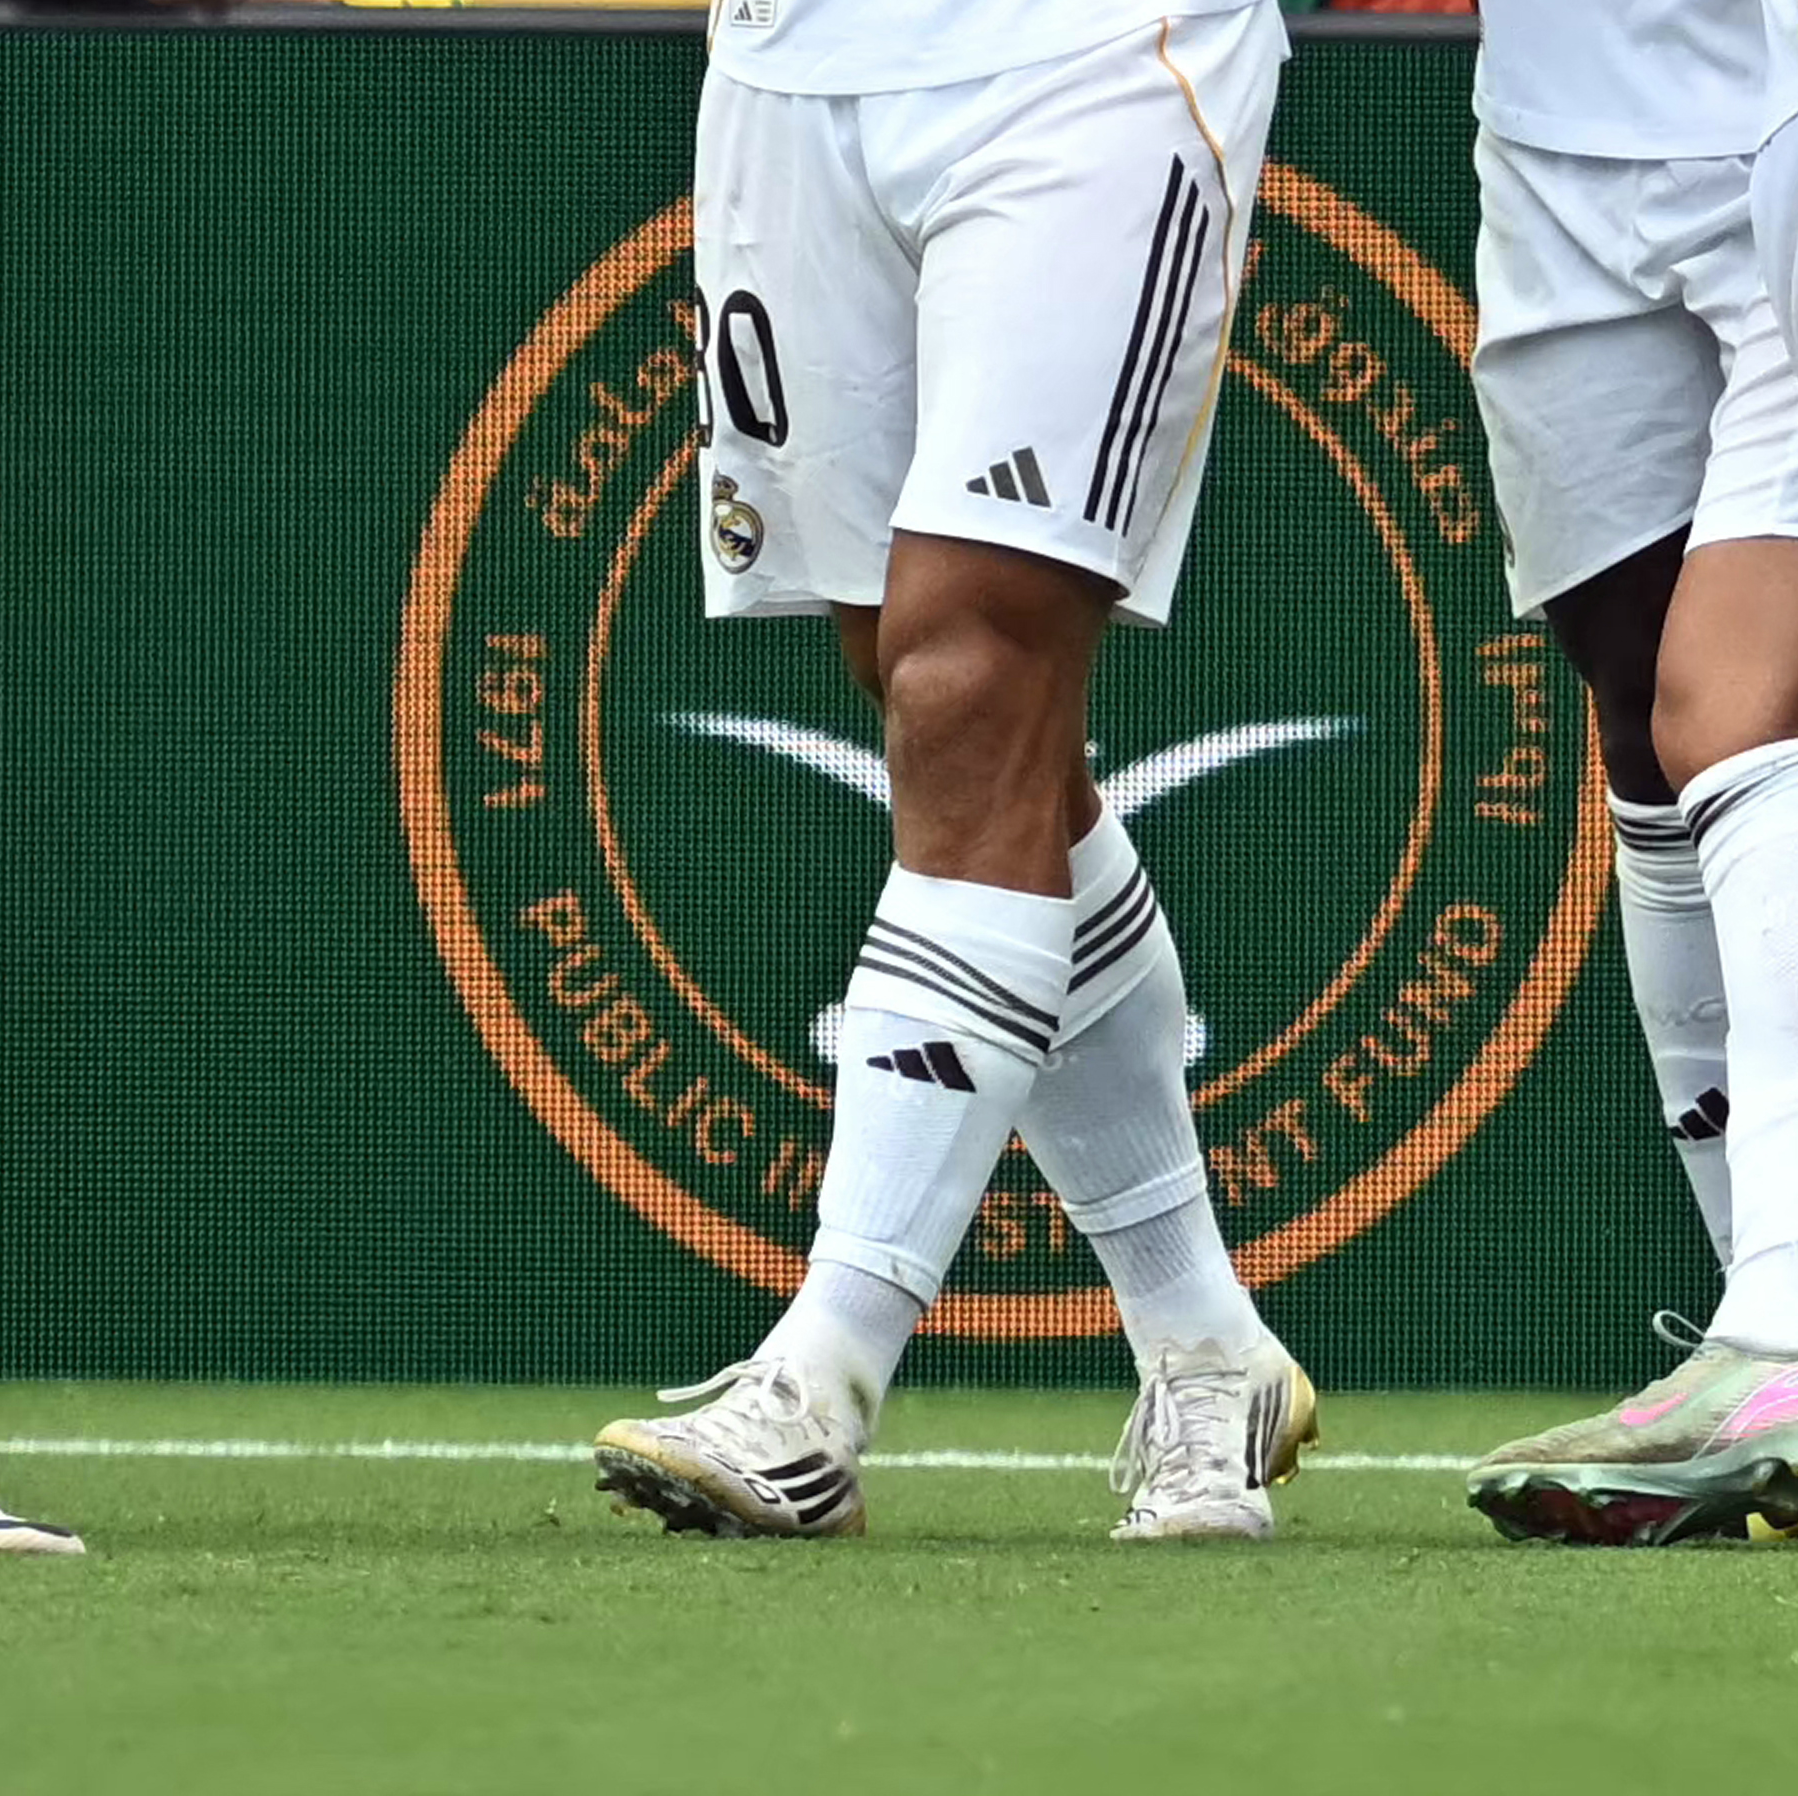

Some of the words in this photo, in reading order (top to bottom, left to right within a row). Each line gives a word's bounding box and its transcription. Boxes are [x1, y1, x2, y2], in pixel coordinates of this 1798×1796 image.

[525, 300, 698, 537] عامة
[520, 888, 756, 1163] PUBLIC
[1323, 901, 1501, 1122] FUND
